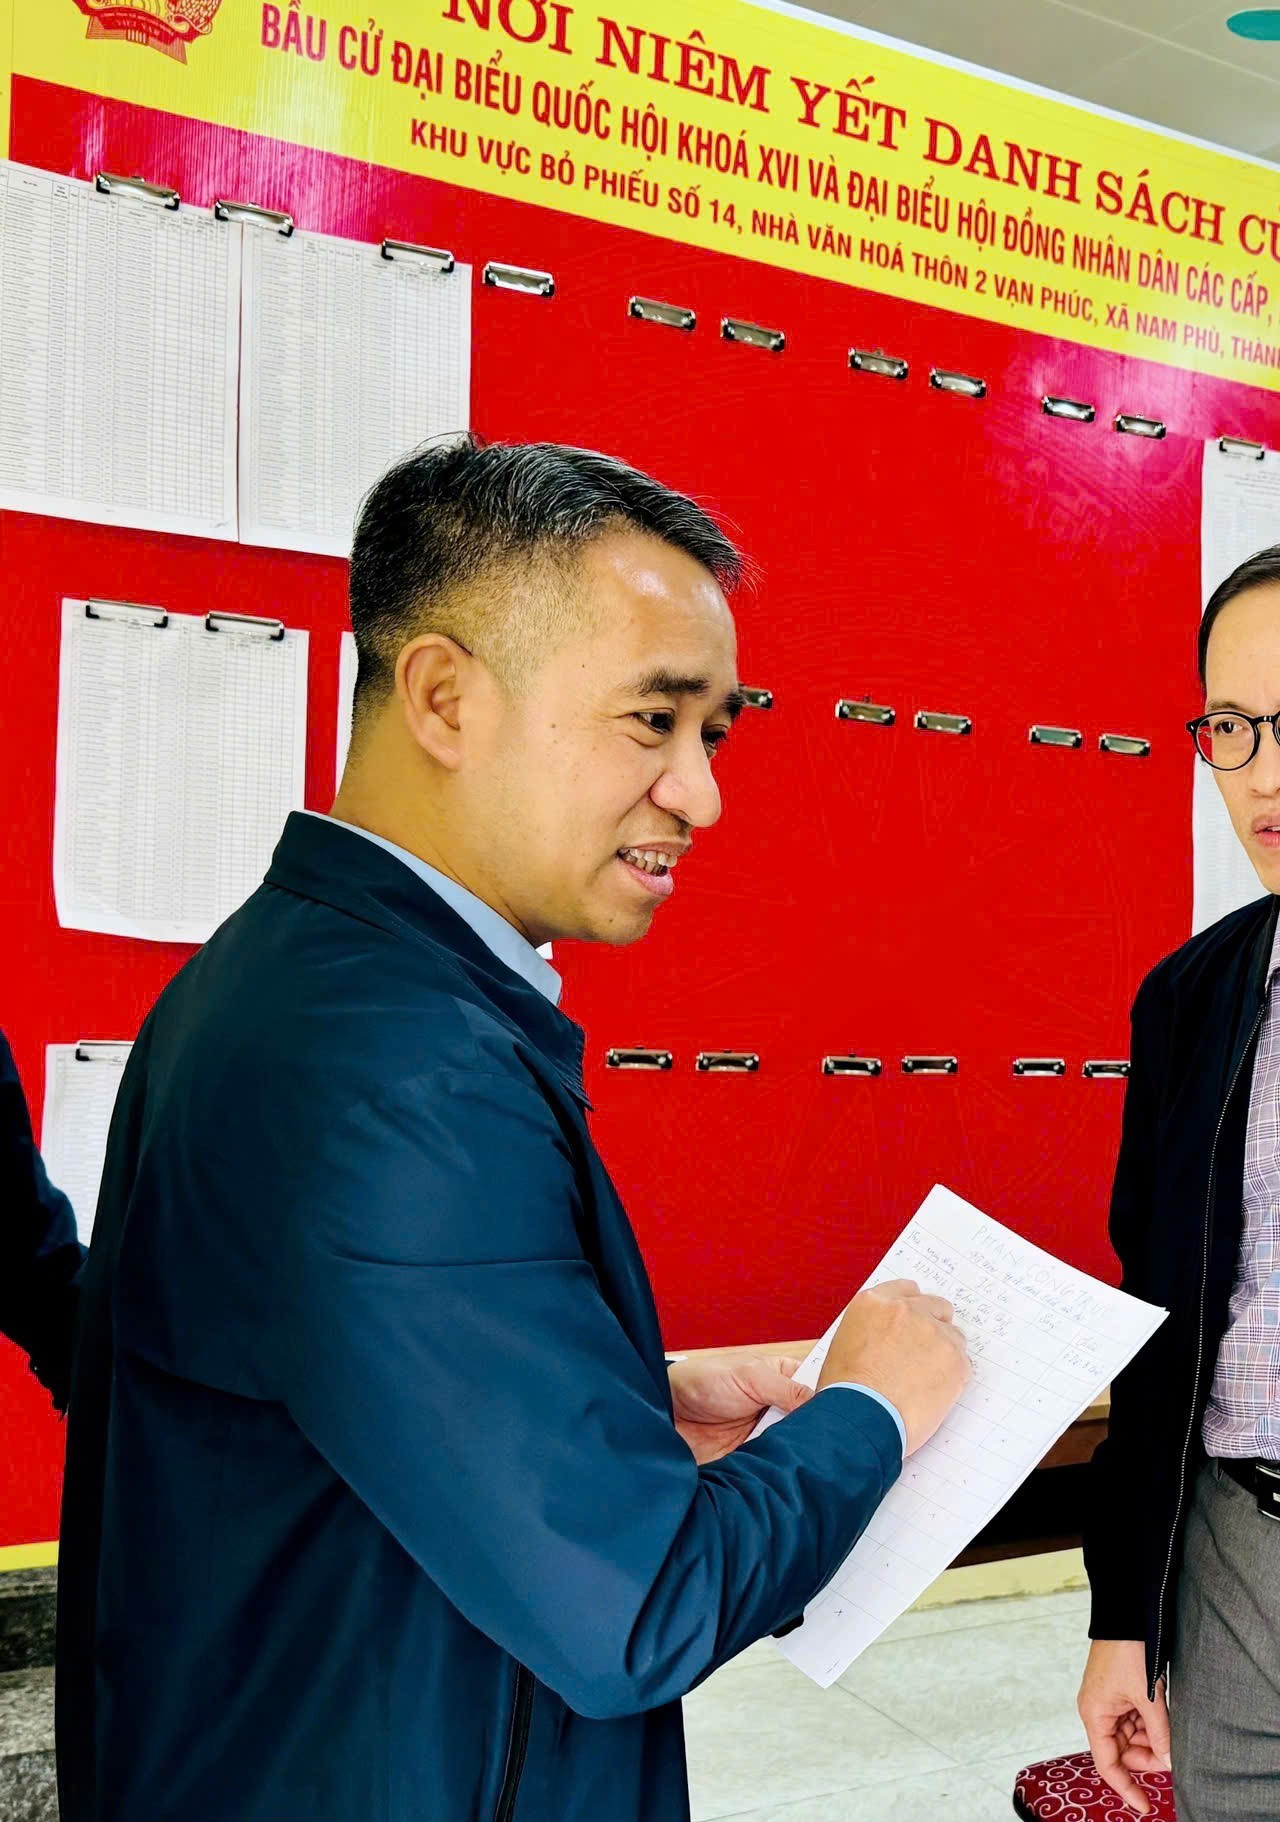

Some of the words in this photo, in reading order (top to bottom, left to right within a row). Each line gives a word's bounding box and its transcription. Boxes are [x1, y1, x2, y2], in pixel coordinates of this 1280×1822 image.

[338, 18, 384, 77] CỬ
[390, 40, 444, 100] ĐẠI
[454, 49, 522, 116] BIỂU
[532, 76, 612, 141] QUỐC
[620, 102, 668, 161] HỘI
[677, 121, 750, 179] KHOÁ
[757, 144, 799, 192] XVI
[808, 154, 840, 203] VÀ
[846, 170, 889, 222] ĐẠI
[896, 174, 950, 234] BIỂU
[957, 198, 997, 253] HỘI
[1002, 209, 1065, 265] ĐỒNG
[1072, 233, 1131, 281] NHÂN
[1138, 252, 1179, 294] DÂN
[1186, 263, 1224, 307] CÁC
[1231, 271, 1273, 326] CẤP,
[410, 118, 468, 158] KHU
[477, 135, 531, 175] VỰC
[540, 149, 575, 186] BỎ
[583, 164, 659, 208] PHIẾU
[667, 183, 703, 219] SỐ
[710, 199, 744, 235] 14,
[751, 209, 800, 245] NHÀ
[807, 224, 852, 258] VĂN
[859, 238, 905, 273] HOÁ
[911, 252, 969, 289] THÔN
[975, 269, 987, 294] 2
[993, 275, 1034, 308] VẠN
[1040, 286, 1099, 327] PHÚC,
[1105, 303, 1130, 331] XÃ
[1136, 312, 1177, 343] NAM
[595, 16, 772, 114] NIÊM
[790, 75, 907, 151] YẾT
[923, 117, 1083, 205] DANH
[1095, 168, 1226, 245] SÁCH
